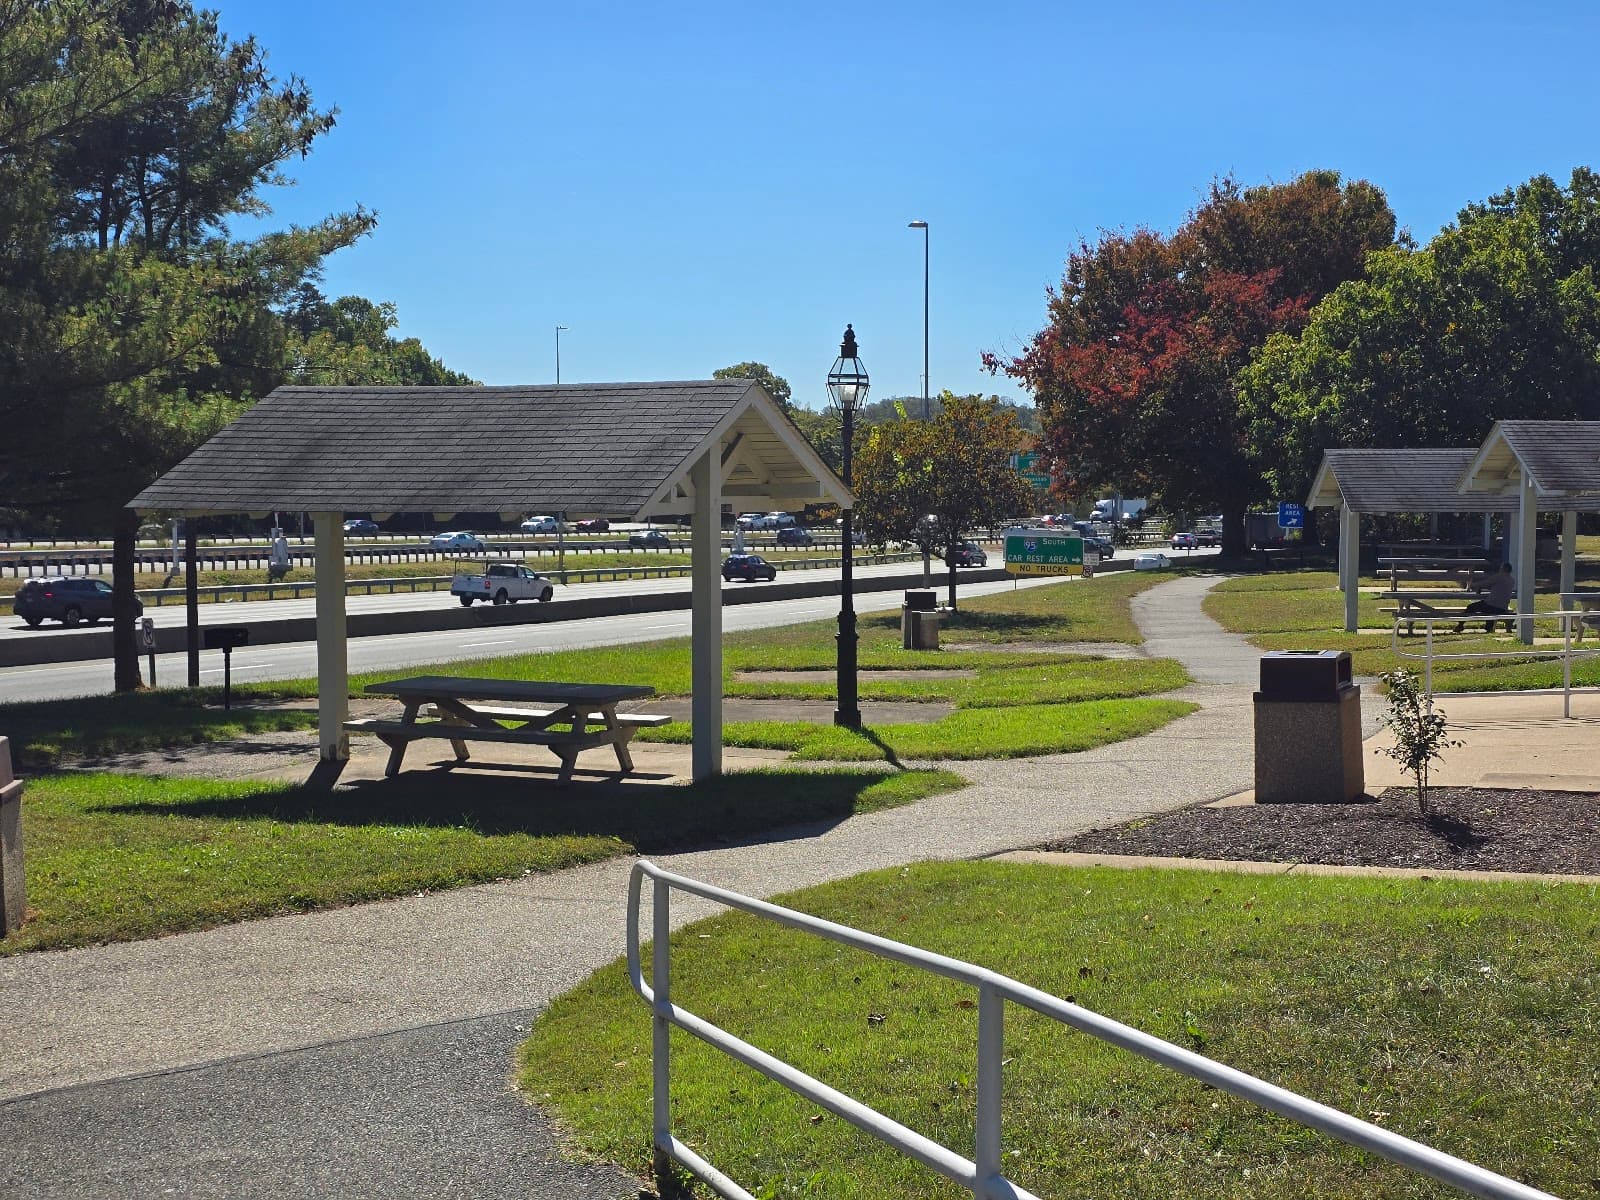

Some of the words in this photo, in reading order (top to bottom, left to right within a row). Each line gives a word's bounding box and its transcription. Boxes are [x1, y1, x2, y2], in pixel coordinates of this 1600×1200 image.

[1025, 541, 1036, 550] 95
[1008, 554, 1022, 562] CAR
[1036, 565, 1069, 573] TRUCKS
